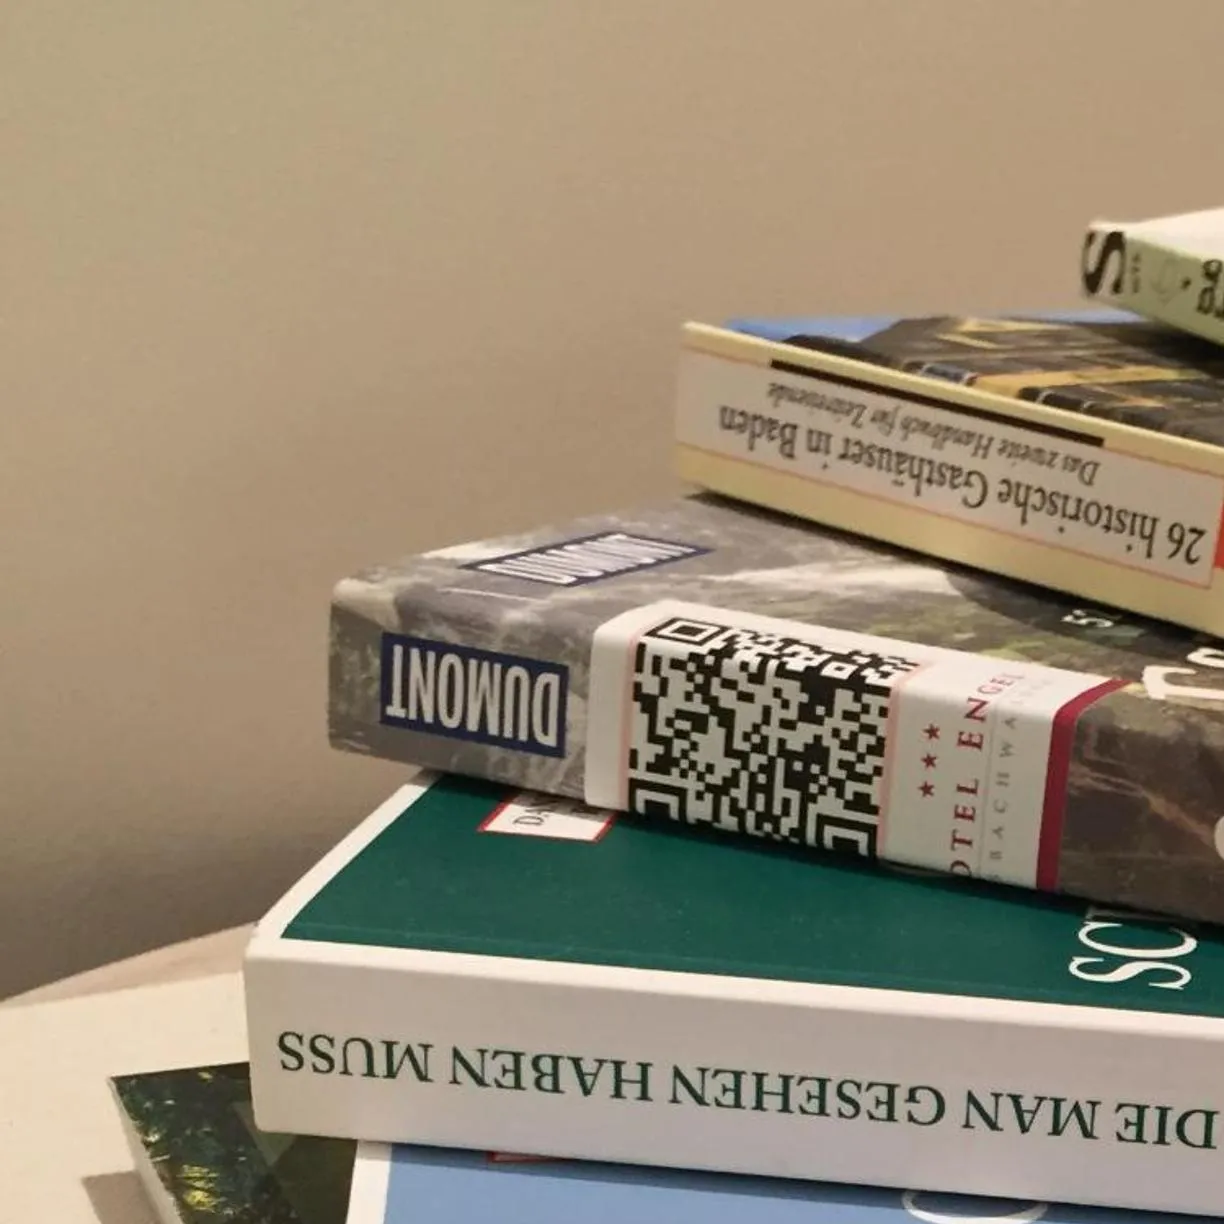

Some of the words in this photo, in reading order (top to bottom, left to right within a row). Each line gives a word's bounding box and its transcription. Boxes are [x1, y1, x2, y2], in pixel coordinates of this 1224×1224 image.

[718, 403, 798, 459] Baden
[807, 428, 832, 470] in
[838, 436, 989, 509] Gasthäuser
[1062, 457, 1102, 486] Das
[998, 479, 1160, 558] historische
[1166, 525, 1207, 566] 26
[386, 643, 561, 747] DUMONT
[277, 1030, 433, 1084] MUSS
[449, 1045, 653, 1101] HABEN
[670, 1064, 946, 1127] GESEHEN
[964, 1090, 1098, 1141] MAN
[1115, 1101, 1220, 1151] DIE
